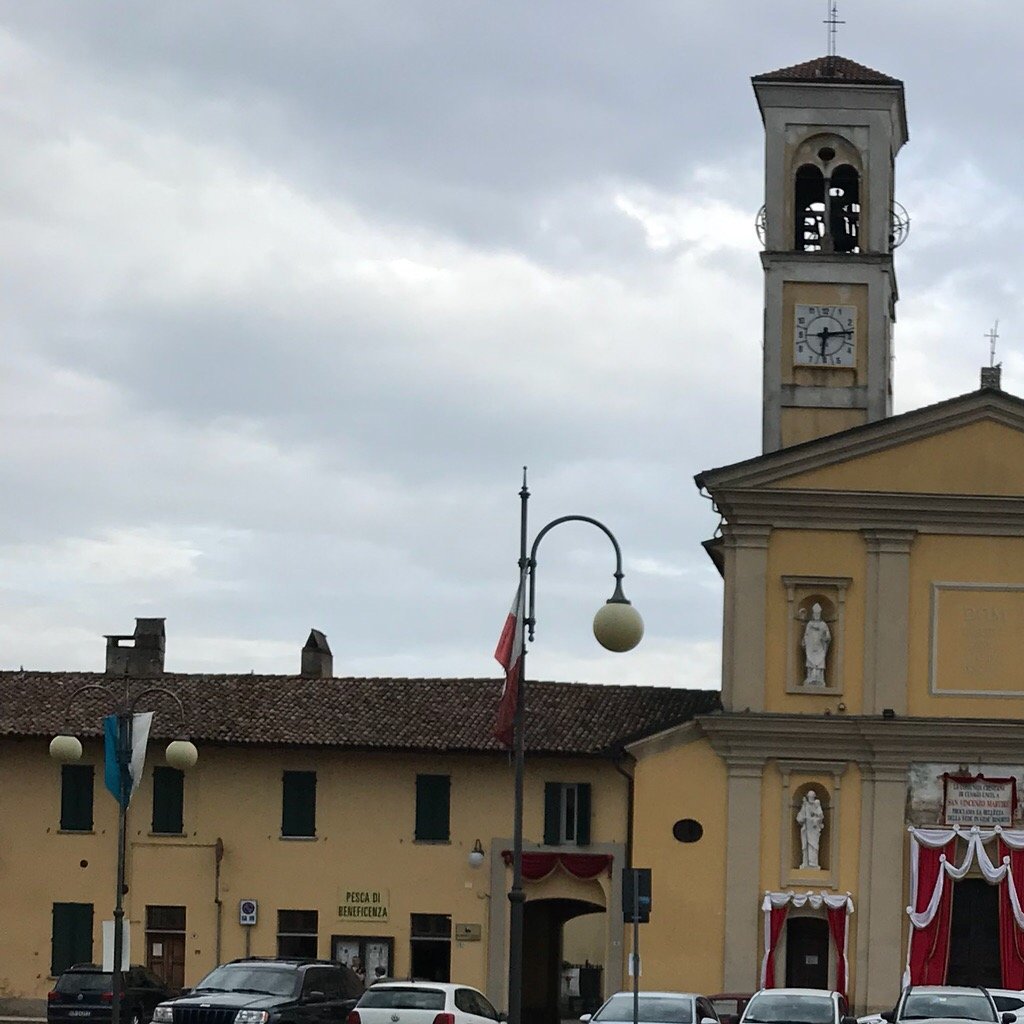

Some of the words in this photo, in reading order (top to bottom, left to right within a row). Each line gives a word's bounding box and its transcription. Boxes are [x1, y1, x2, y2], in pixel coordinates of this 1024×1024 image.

[346, 891, 370, 903] PESCA
[372, 892, 381, 903] DI
[338, 905, 388, 918] BENEFICENZA
